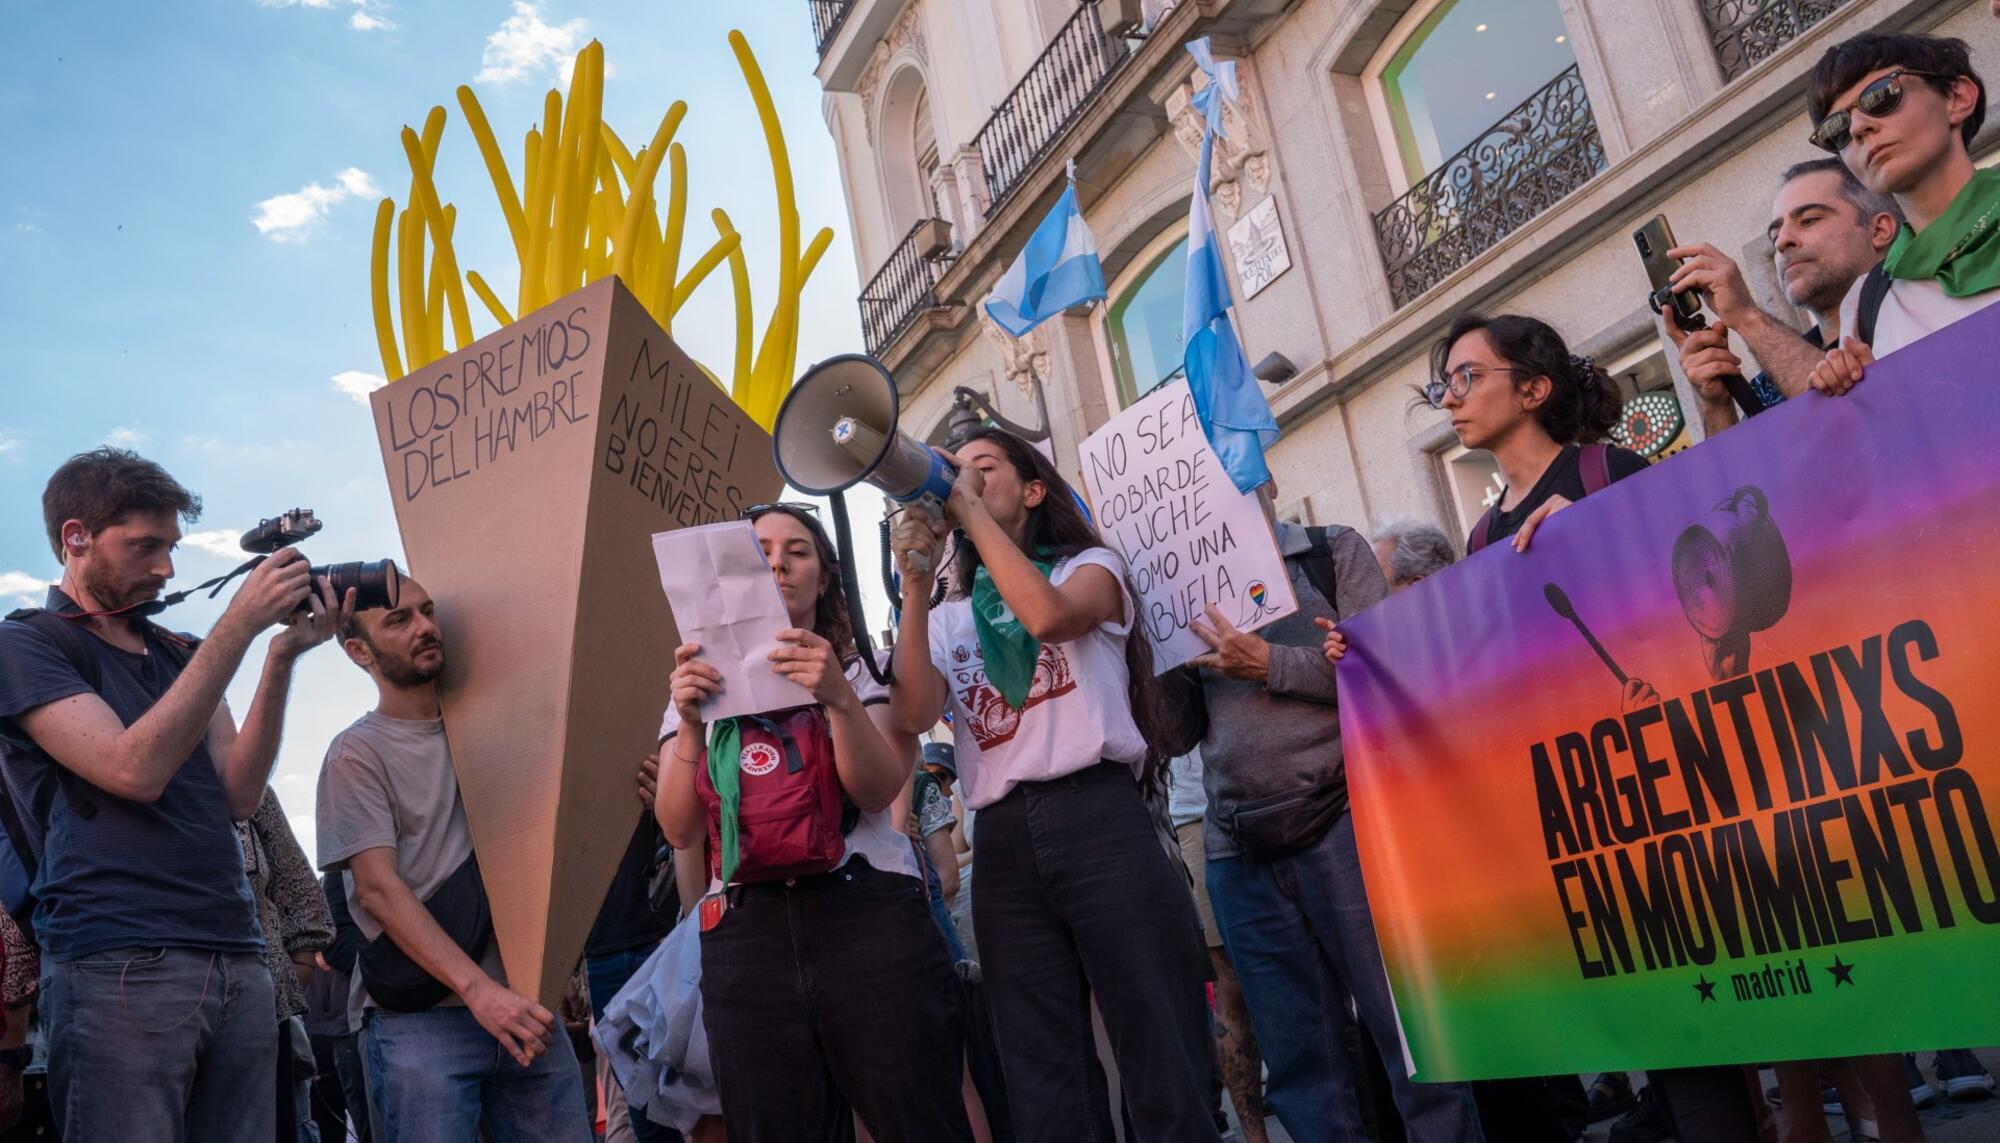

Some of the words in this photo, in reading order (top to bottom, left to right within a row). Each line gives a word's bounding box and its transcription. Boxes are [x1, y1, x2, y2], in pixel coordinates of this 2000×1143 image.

[387, 373, 460, 452] LOS
[403, 430, 471, 502] DEL
[473, 370, 589, 471] HAMBRE
[610, 393, 658, 459] NO
[663, 436, 743, 520] ERES
[1089, 432, 1127, 495] NO
[1136, 393, 1199, 455] SEA
[1100, 448, 1206, 529] COBARDE
[1116, 482, 1213, 566] LUCHE
[1188, 521, 1237, 566] UNA
[1530, 619, 1964, 860] ARGENTINXS
[1552, 850, 1636, 980] EN
[1616, 767, 2000, 971] MOVIMIENTO
[1731, 958, 1813, 1002] madrid
